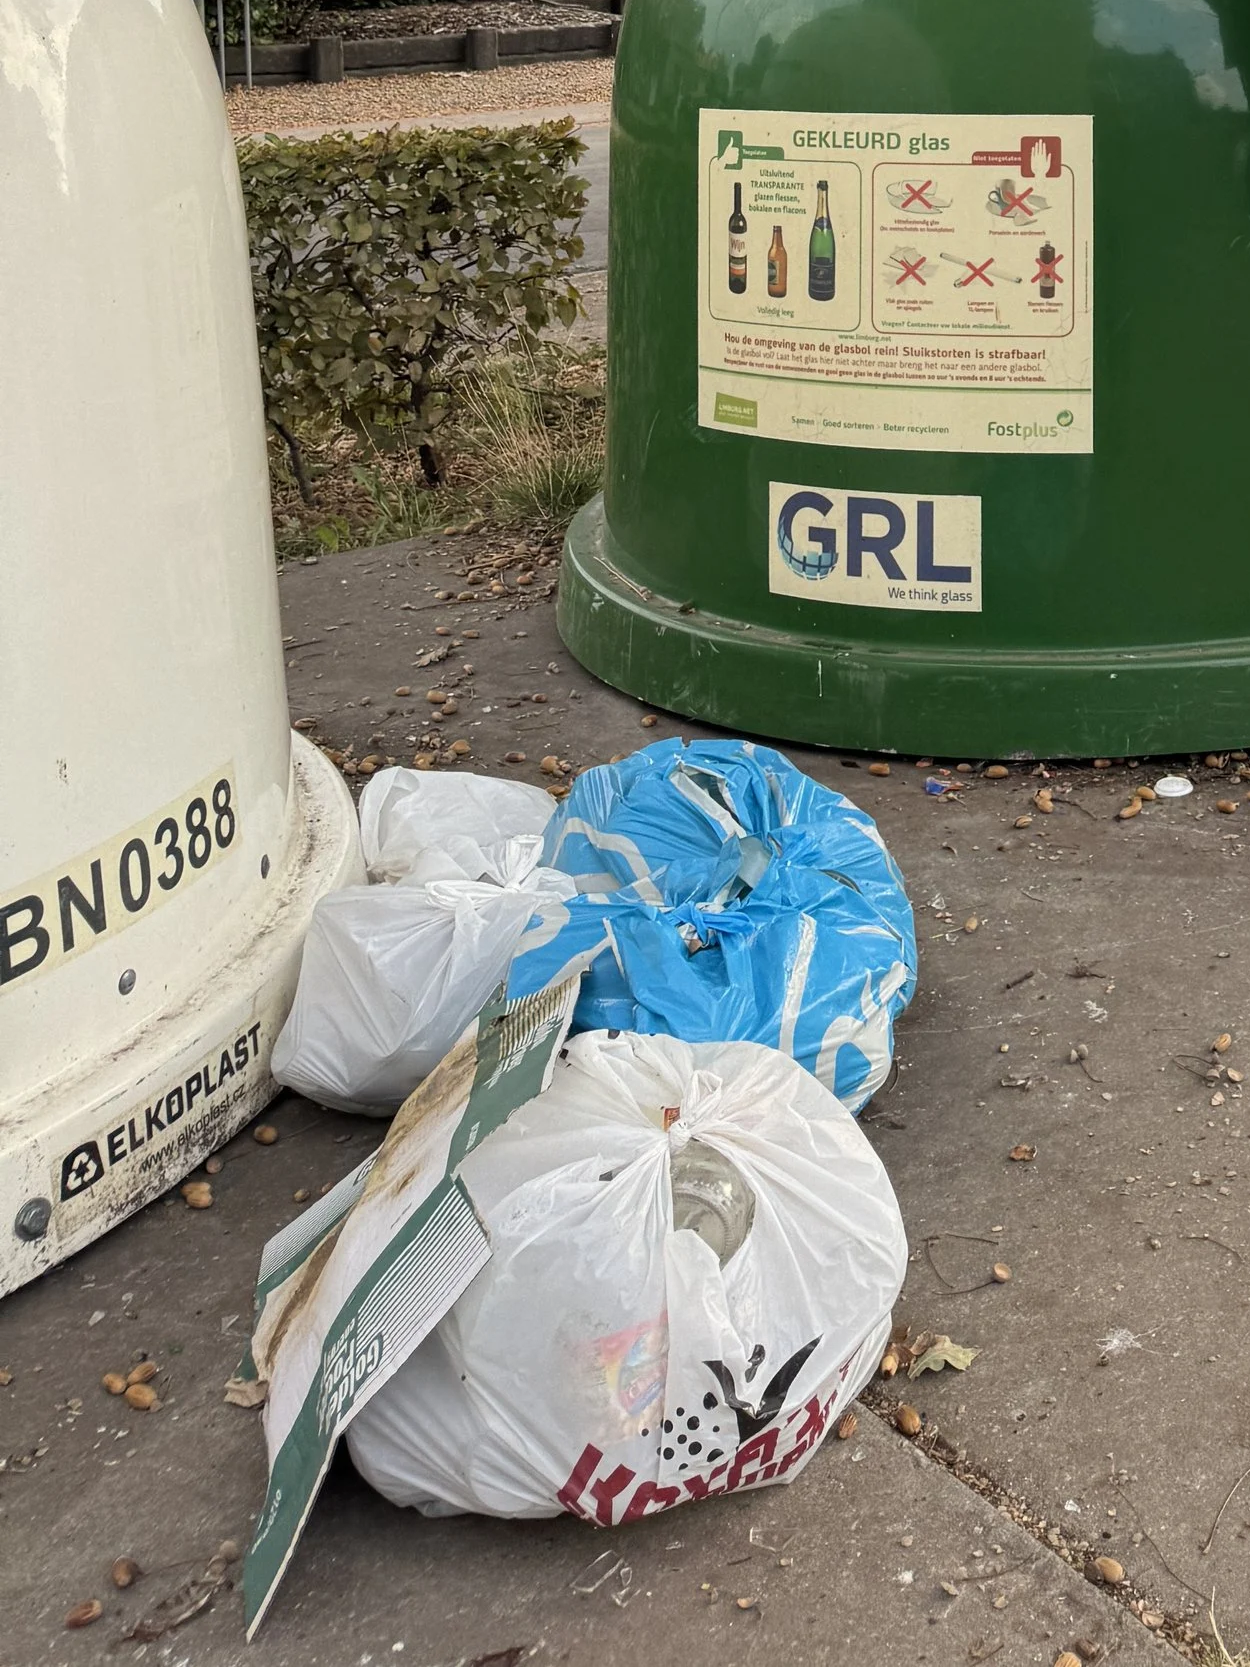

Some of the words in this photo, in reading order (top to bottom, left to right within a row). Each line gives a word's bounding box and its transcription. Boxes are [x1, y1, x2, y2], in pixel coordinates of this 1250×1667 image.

[793, 130, 901, 149] GEKLEURD
[908, 133, 950, 154] glas
[760, 169, 794, 178] Uitsluitend
[751, 180, 804, 190] TRANSPARANTE
[754, 192, 773, 202] glazen
[749, 203, 772, 213] bokalen
[783, 205, 806, 214] flacons
[730, 237, 746, 252] Wijn
[781, 307, 794, 318] leeg
[724, 332, 740, 344] Hou
[742, 335, 752, 346] de
[754, 338, 796, 352] omgeving
[799, 342, 815, 352] van
[818, 342, 830, 353] de
[834, 344, 871, 355] glasbol
[874, 346, 898, 356] rein!
[902, 346, 971, 359] Sluikstorten
[975, 349, 985, 359] is
[988, 349, 1046, 360] strafbaar!
[733, 347, 740, 355] de
[741, 348, 761, 358] glasbol
[776, 352, 790, 361] Laat
[791, 353, 803, 363] het
[804, 354, 818, 365] glas
[820, 355, 834, 365] hier
[835, 357, 850, 366] niet
[851, 358, 875, 367] achter
[877, 360, 897, 368] maar
[899, 360, 923, 371] breng
[924, 361, 937, 370] het
[940, 363, 958, 371] naar
[960, 363, 976, 371] een
[978, 363, 1007, 372] andere
[1009, 363, 1042, 374] glasbol.
[853, 370, 866, 378] glas
[882, 371, 905, 380] glasbol
[791, 416, 815, 426] Samen
[822, 418, 842, 428] Goed
[843, 421, 875, 431] sorteren
[883, 423, 905, 432] Beter
[907, 424, 950, 435] recycleren
[987, 421, 1058, 440] Fostplus
[777, 491, 972, 583] GRL
[888, 587, 906, 600] We
[908, 588, 938, 601] think
[941, 591, 973, 604] glass
[106, 1021, 261, 1166] ELKOPLAST
